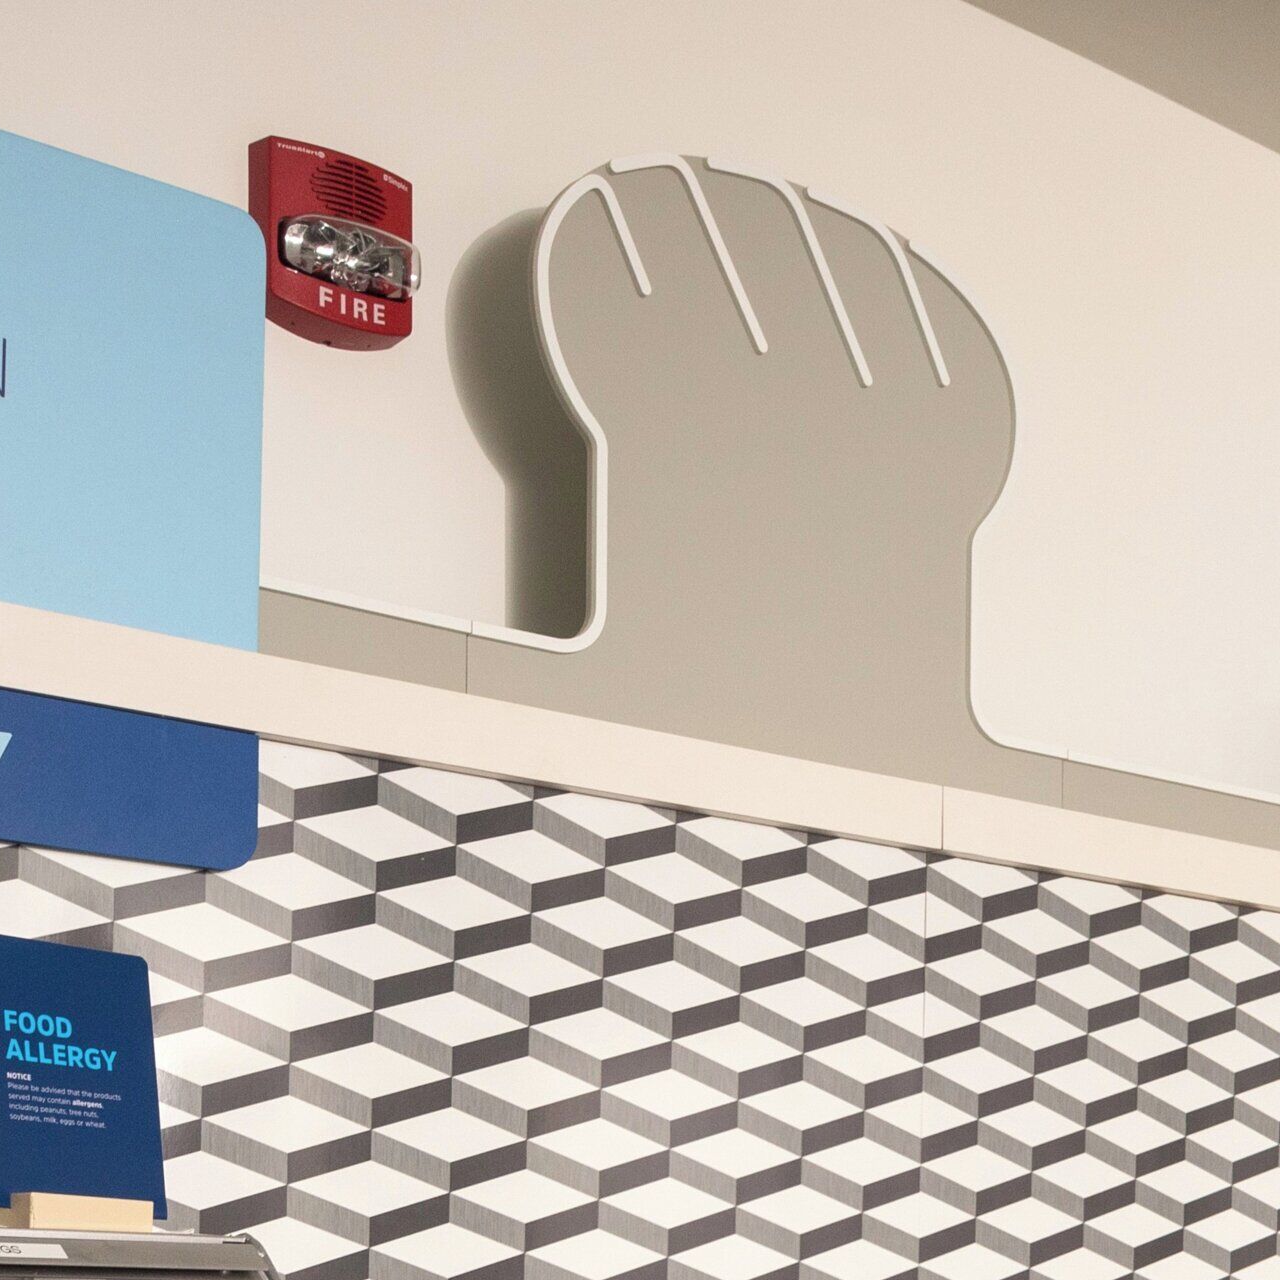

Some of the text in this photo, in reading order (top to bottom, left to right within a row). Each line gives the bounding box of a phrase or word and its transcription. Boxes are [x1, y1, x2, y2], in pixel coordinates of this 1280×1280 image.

[319, 286, 385, 325] FIRE
[4, 1009, 72, 1038] FOOD
[6, 1038, 117, 1071] ALLERGY
[6, 1071, 31, 1081] NOTICE
[7, 1082, 29, 1091] Please
[41, 1086, 65, 1095] advised
[8, 1093, 30, 1101] served
[47, 1096, 71, 1105] contain
